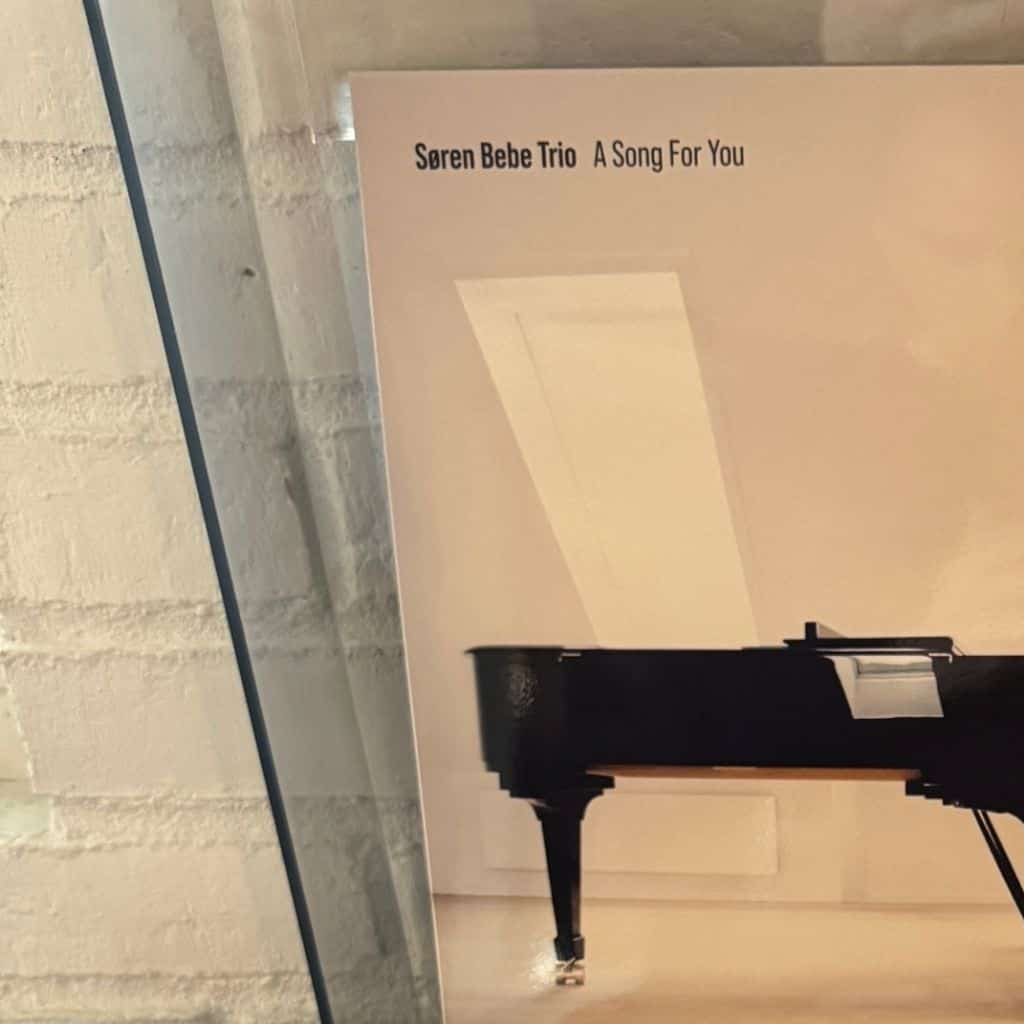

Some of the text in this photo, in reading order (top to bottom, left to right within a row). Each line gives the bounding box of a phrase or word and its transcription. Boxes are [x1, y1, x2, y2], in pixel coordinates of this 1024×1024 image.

[415, 138, 744, 173] Søren Bebe Trio A Song For You
